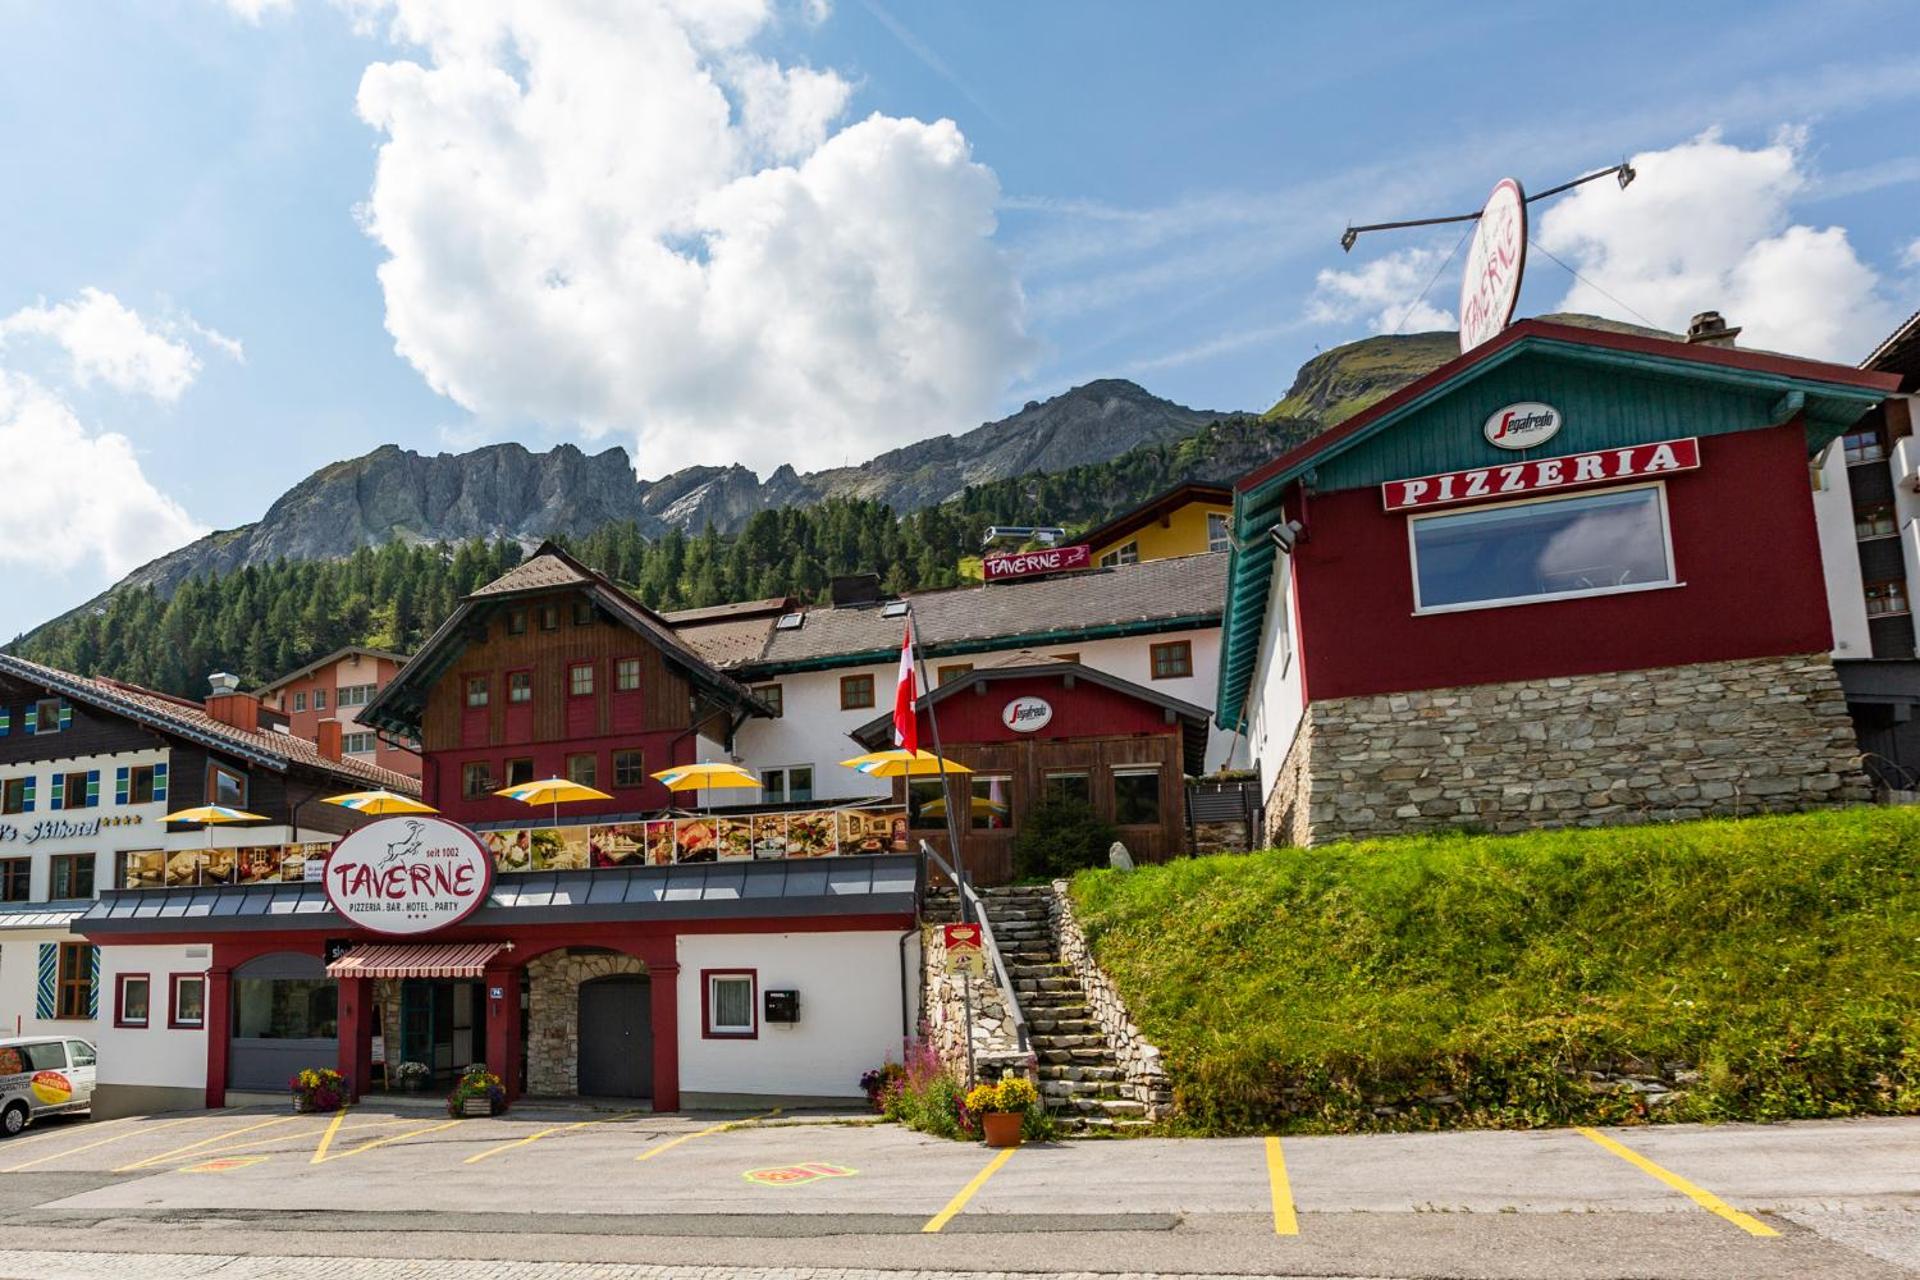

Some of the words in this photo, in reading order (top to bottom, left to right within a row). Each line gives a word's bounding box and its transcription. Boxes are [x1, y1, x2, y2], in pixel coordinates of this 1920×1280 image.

[1493, 411, 1554, 439] Segafredo
[1401, 444, 1680, 507] PIZZERIA
[987, 552, 1061, 575] TAVERNE
[24, 817, 102, 845] Skihotel
[426, 847, 440, 858] seit
[442, 847, 460, 858] 1002
[334, 859, 475, 900] TAVERNE
[348, 902, 381, 912] PIZZERIA
[386, 902, 401, 912] BAR
[406, 902, 429, 912] HOTEL
[434, 901, 459, 912] PARTY
